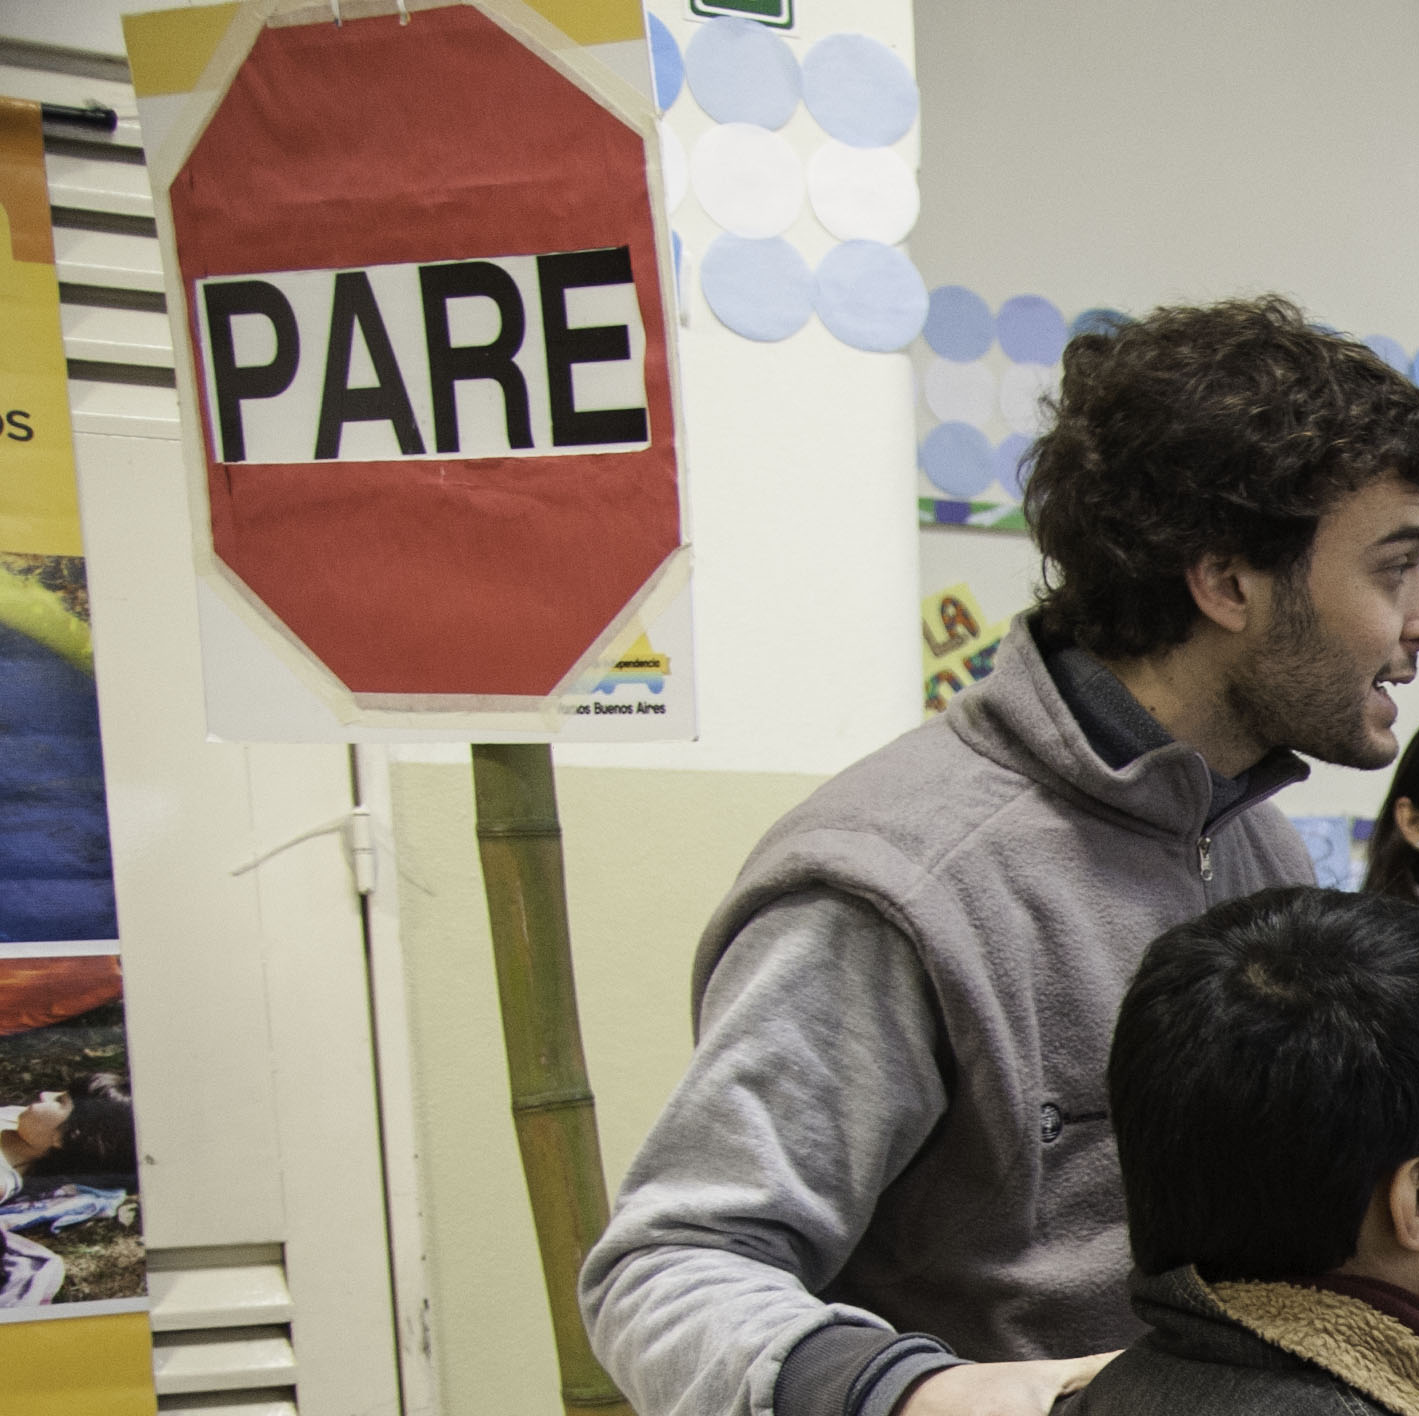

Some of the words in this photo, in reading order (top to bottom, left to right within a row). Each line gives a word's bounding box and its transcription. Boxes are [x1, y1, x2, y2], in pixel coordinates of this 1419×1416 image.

[203, 246, 648, 462] PARE
[0, 411, 34, 443] s
[594, 702, 634, 715] Buenos
[636, 702, 666, 715] Aires
